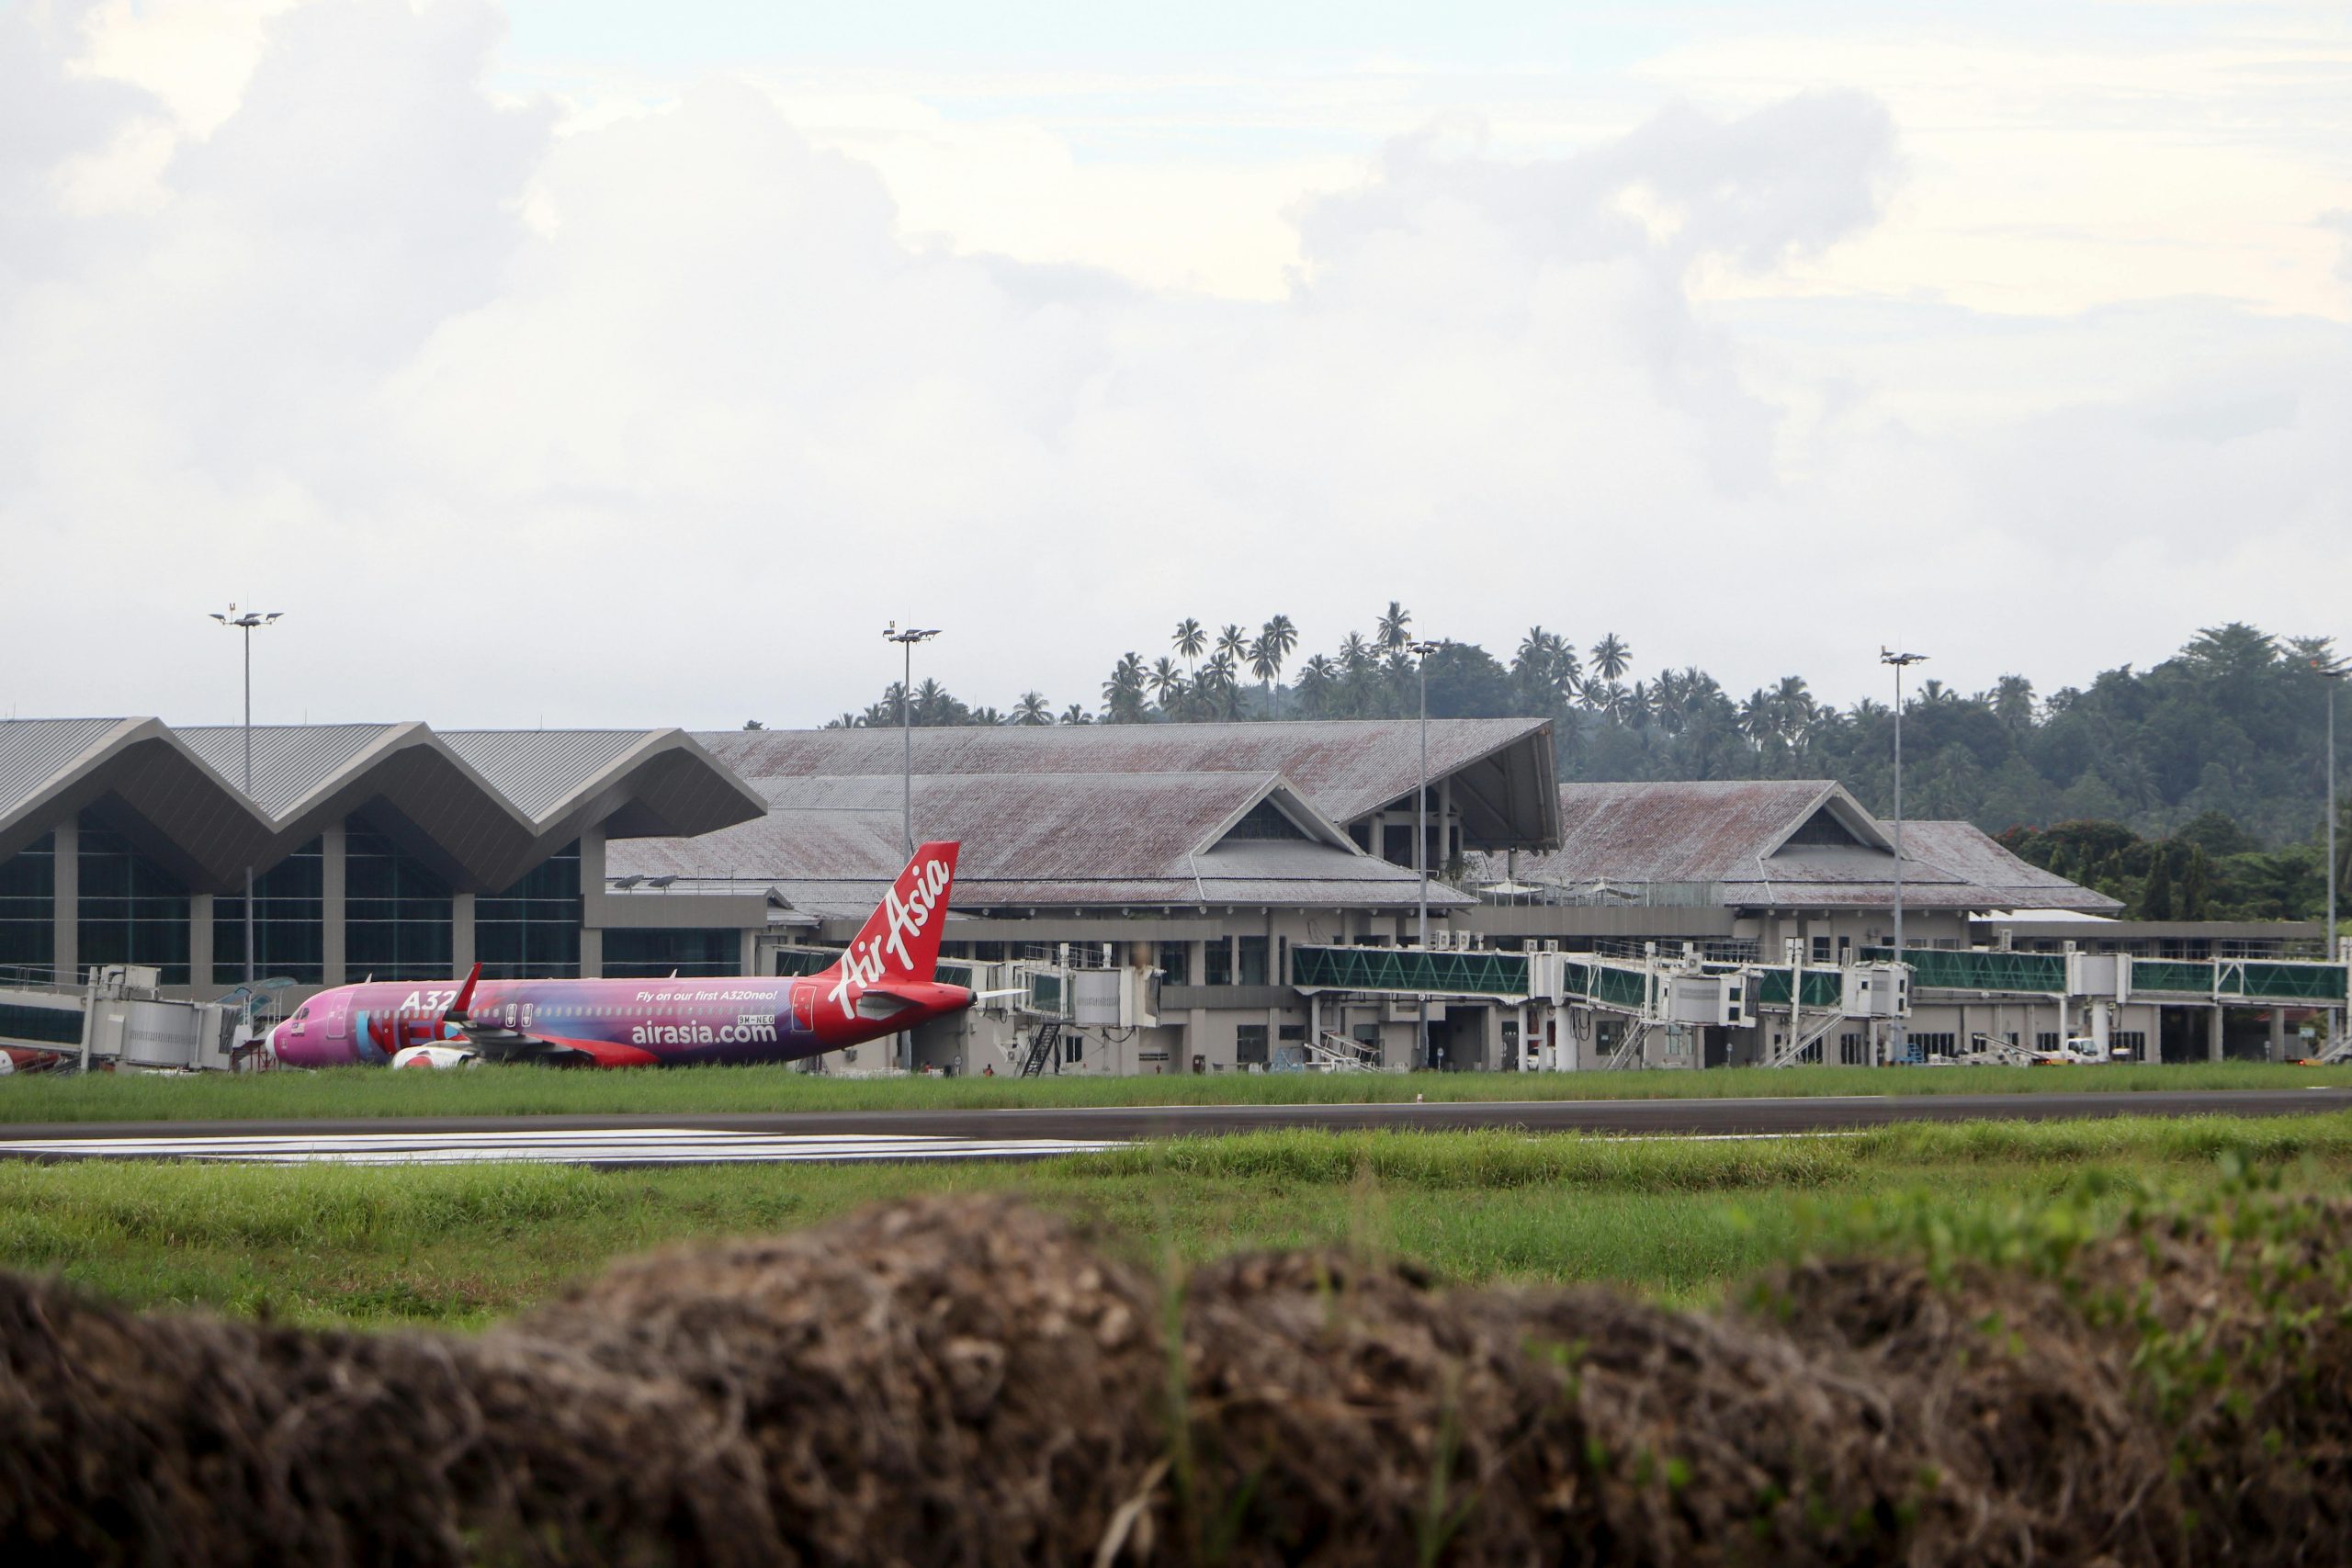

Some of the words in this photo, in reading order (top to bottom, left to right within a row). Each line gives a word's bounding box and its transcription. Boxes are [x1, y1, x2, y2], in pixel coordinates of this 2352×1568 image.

[399, 990, 477, 1011] A32
[636, 991, 654, 1003] Fly
[656, 993, 672, 1001] on
[673, 993, 693, 1001] our
[695, 990, 718, 1000] first
[719, 990, 778, 1000] A320neo!
[739, 1015, 775, 1024] 9M-NEO
[632, 1020, 777, 1043] airasia.com
